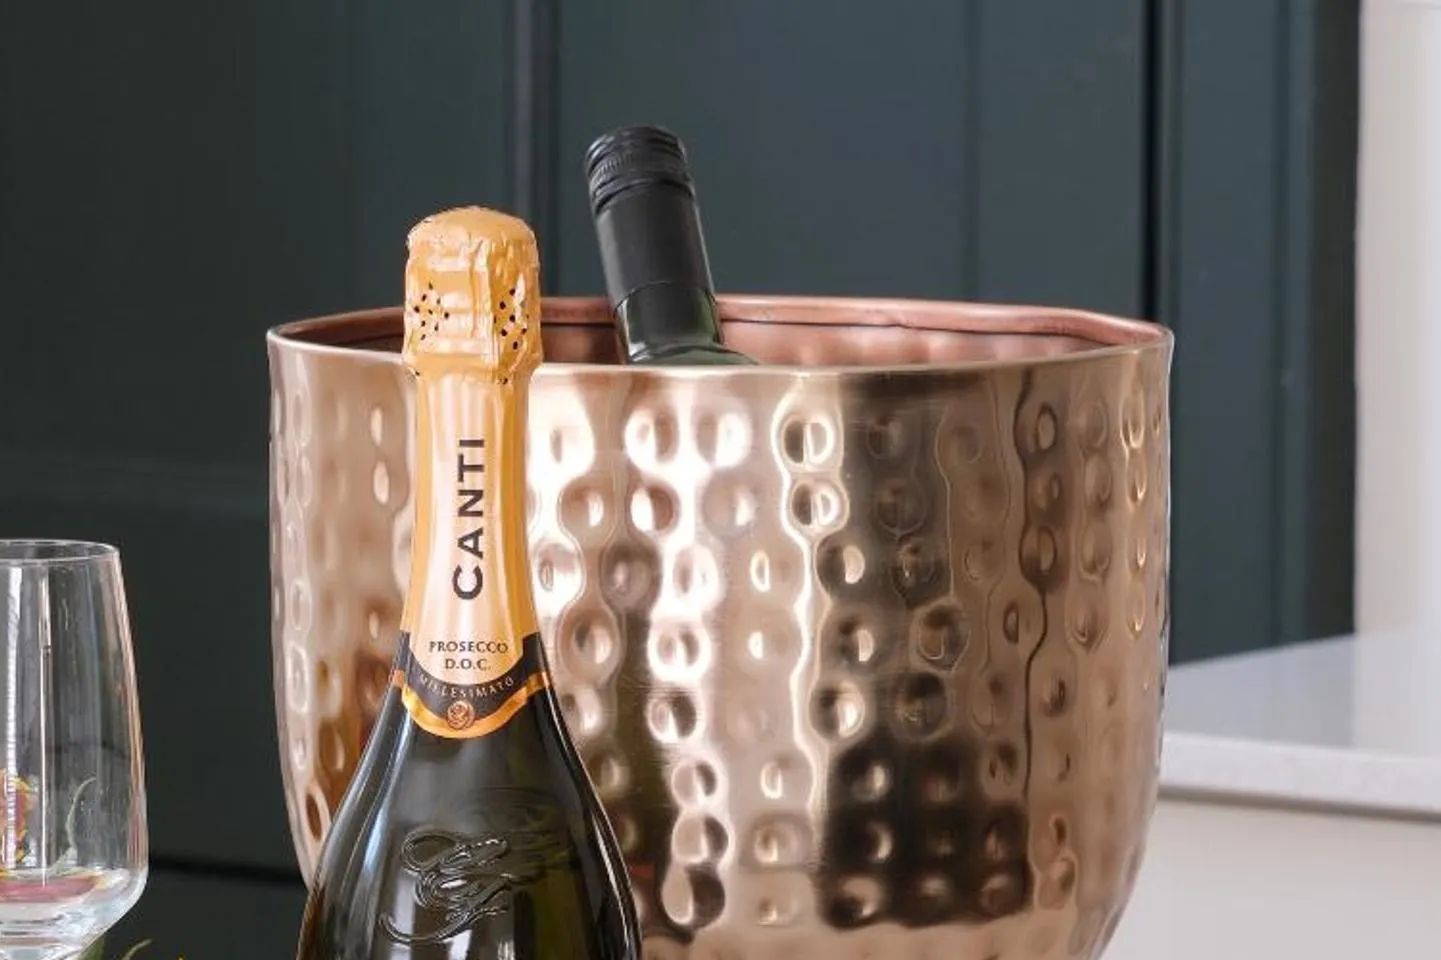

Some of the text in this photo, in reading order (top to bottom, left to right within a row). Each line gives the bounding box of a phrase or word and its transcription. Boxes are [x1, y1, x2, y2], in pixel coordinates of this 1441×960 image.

[452, 438, 485, 600] CANTI
[428, 641, 509, 654] PROSECCO
[419, 673, 515, 698] MILLESIMATO
